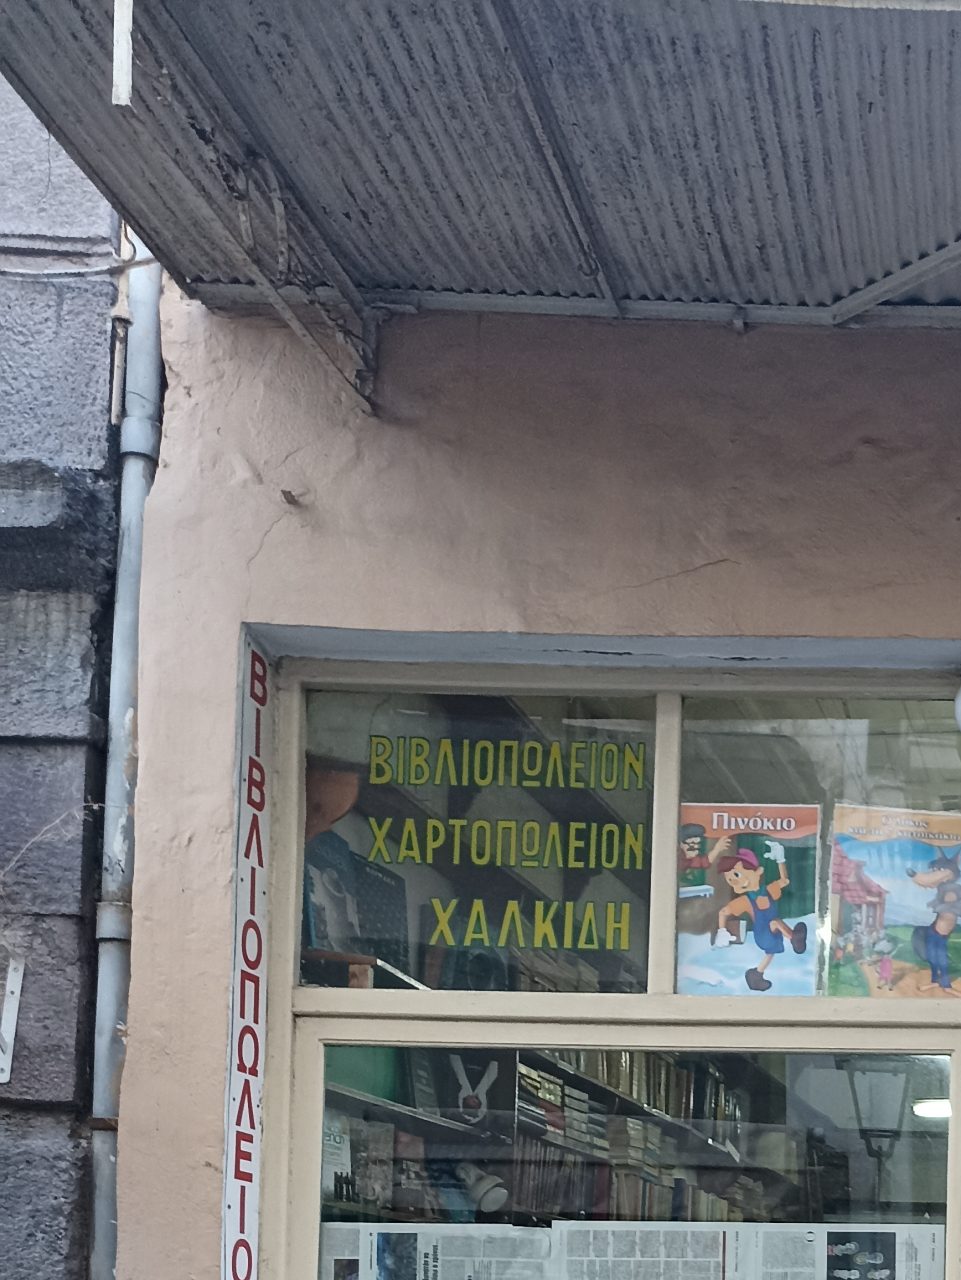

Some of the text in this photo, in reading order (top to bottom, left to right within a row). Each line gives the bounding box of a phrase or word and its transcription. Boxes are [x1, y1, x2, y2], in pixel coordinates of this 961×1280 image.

[369, 735, 646, 791] ΒΙΒΛΙΟΠΩΛΕΙΟΝ
[368, 816, 645, 870] ΧΑΡΤΟΠΩΛΕΙΟΝ
[712, 811, 796, 831] Πινόκιο
[429, 897, 631, 951] ΧΑΛΚΙΔΗ
